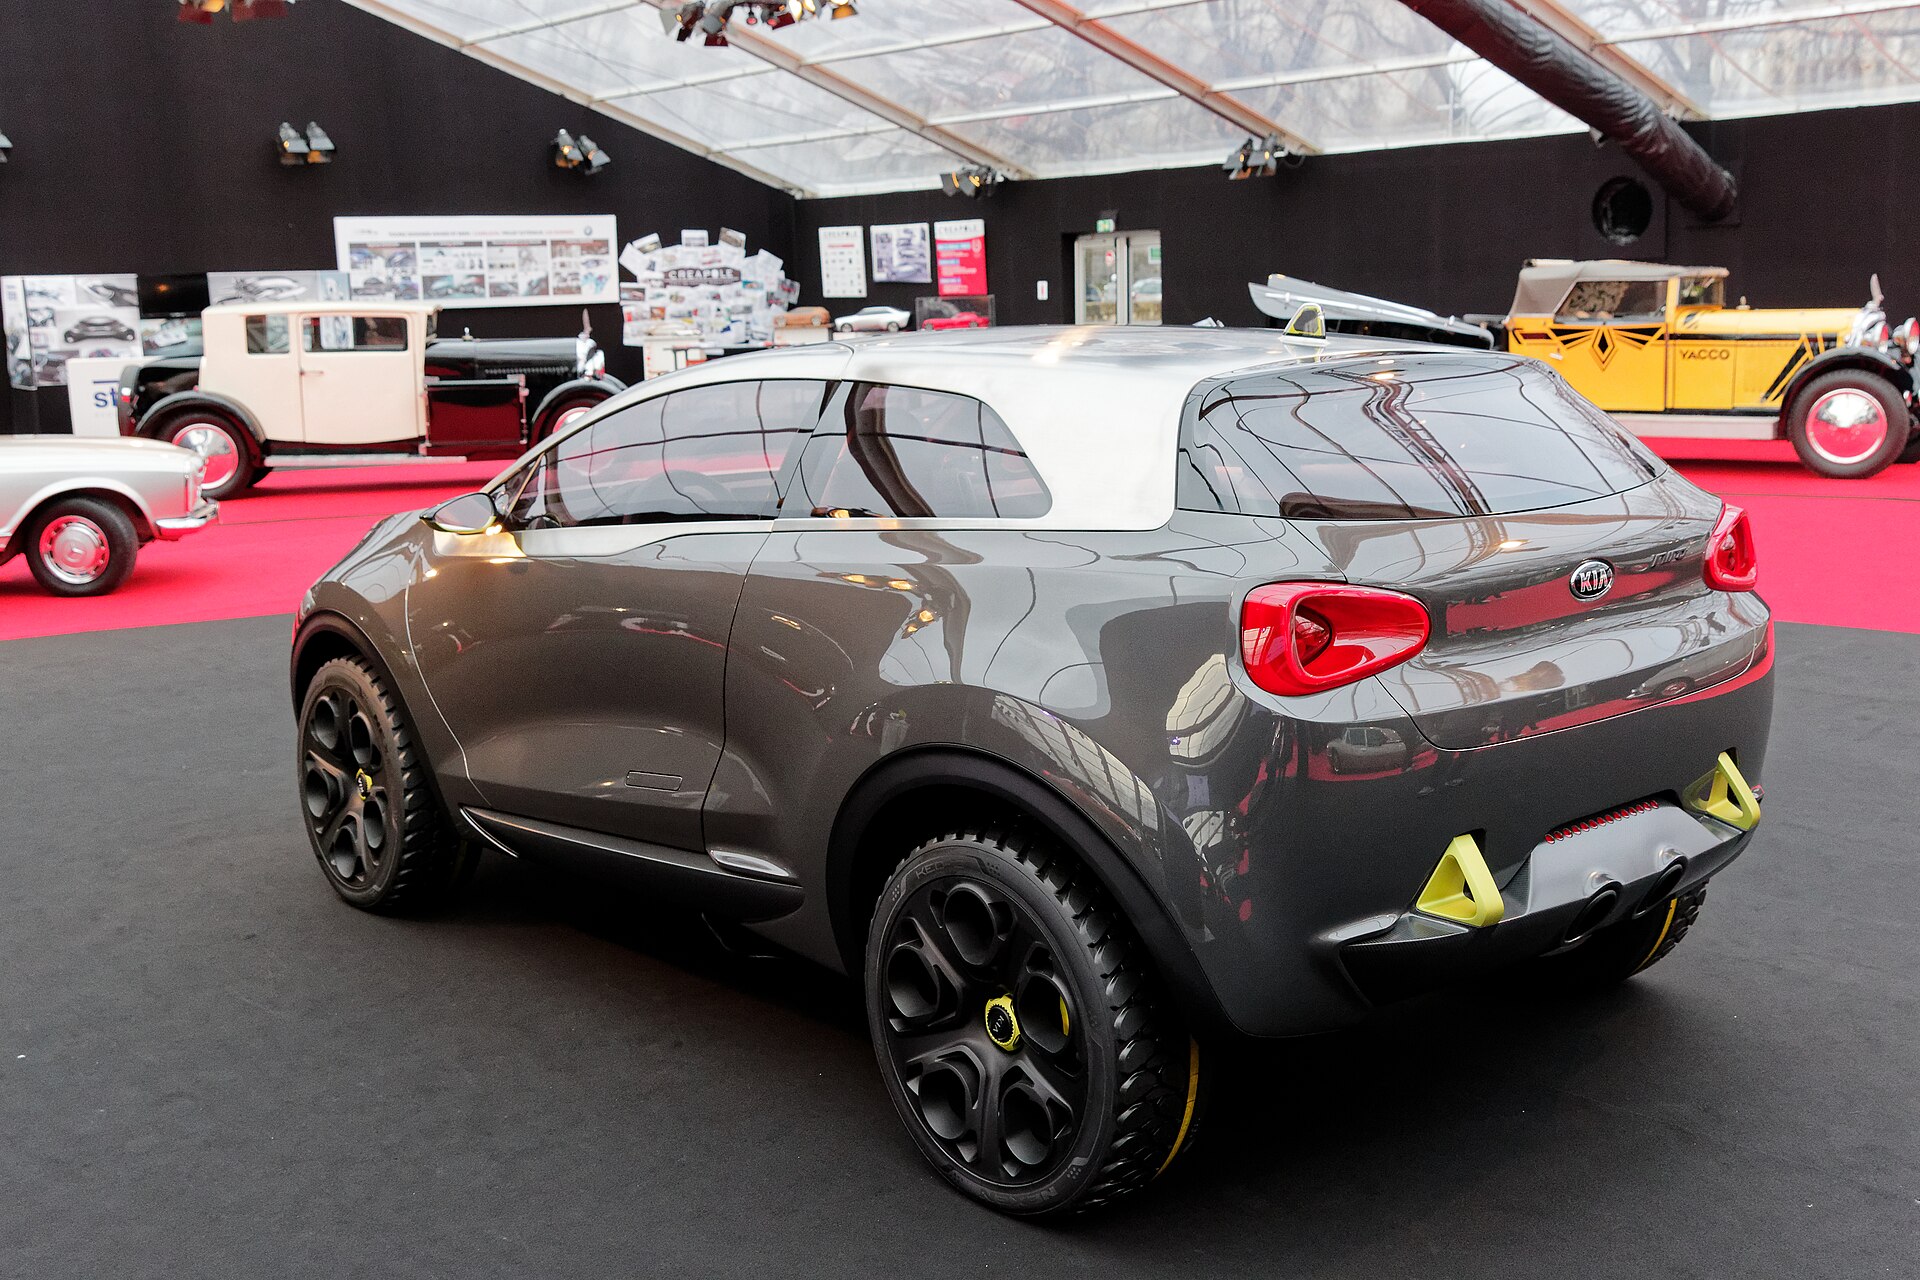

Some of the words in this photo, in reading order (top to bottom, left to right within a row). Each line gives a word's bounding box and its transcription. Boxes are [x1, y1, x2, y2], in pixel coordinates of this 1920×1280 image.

[668, 267, 734, 280] CREAPOLE
[1679, 349, 1730, 360] YACCO
[1579, 568, 1608, 592] KIA
[992, 1015, 1004, 1033] KIA
